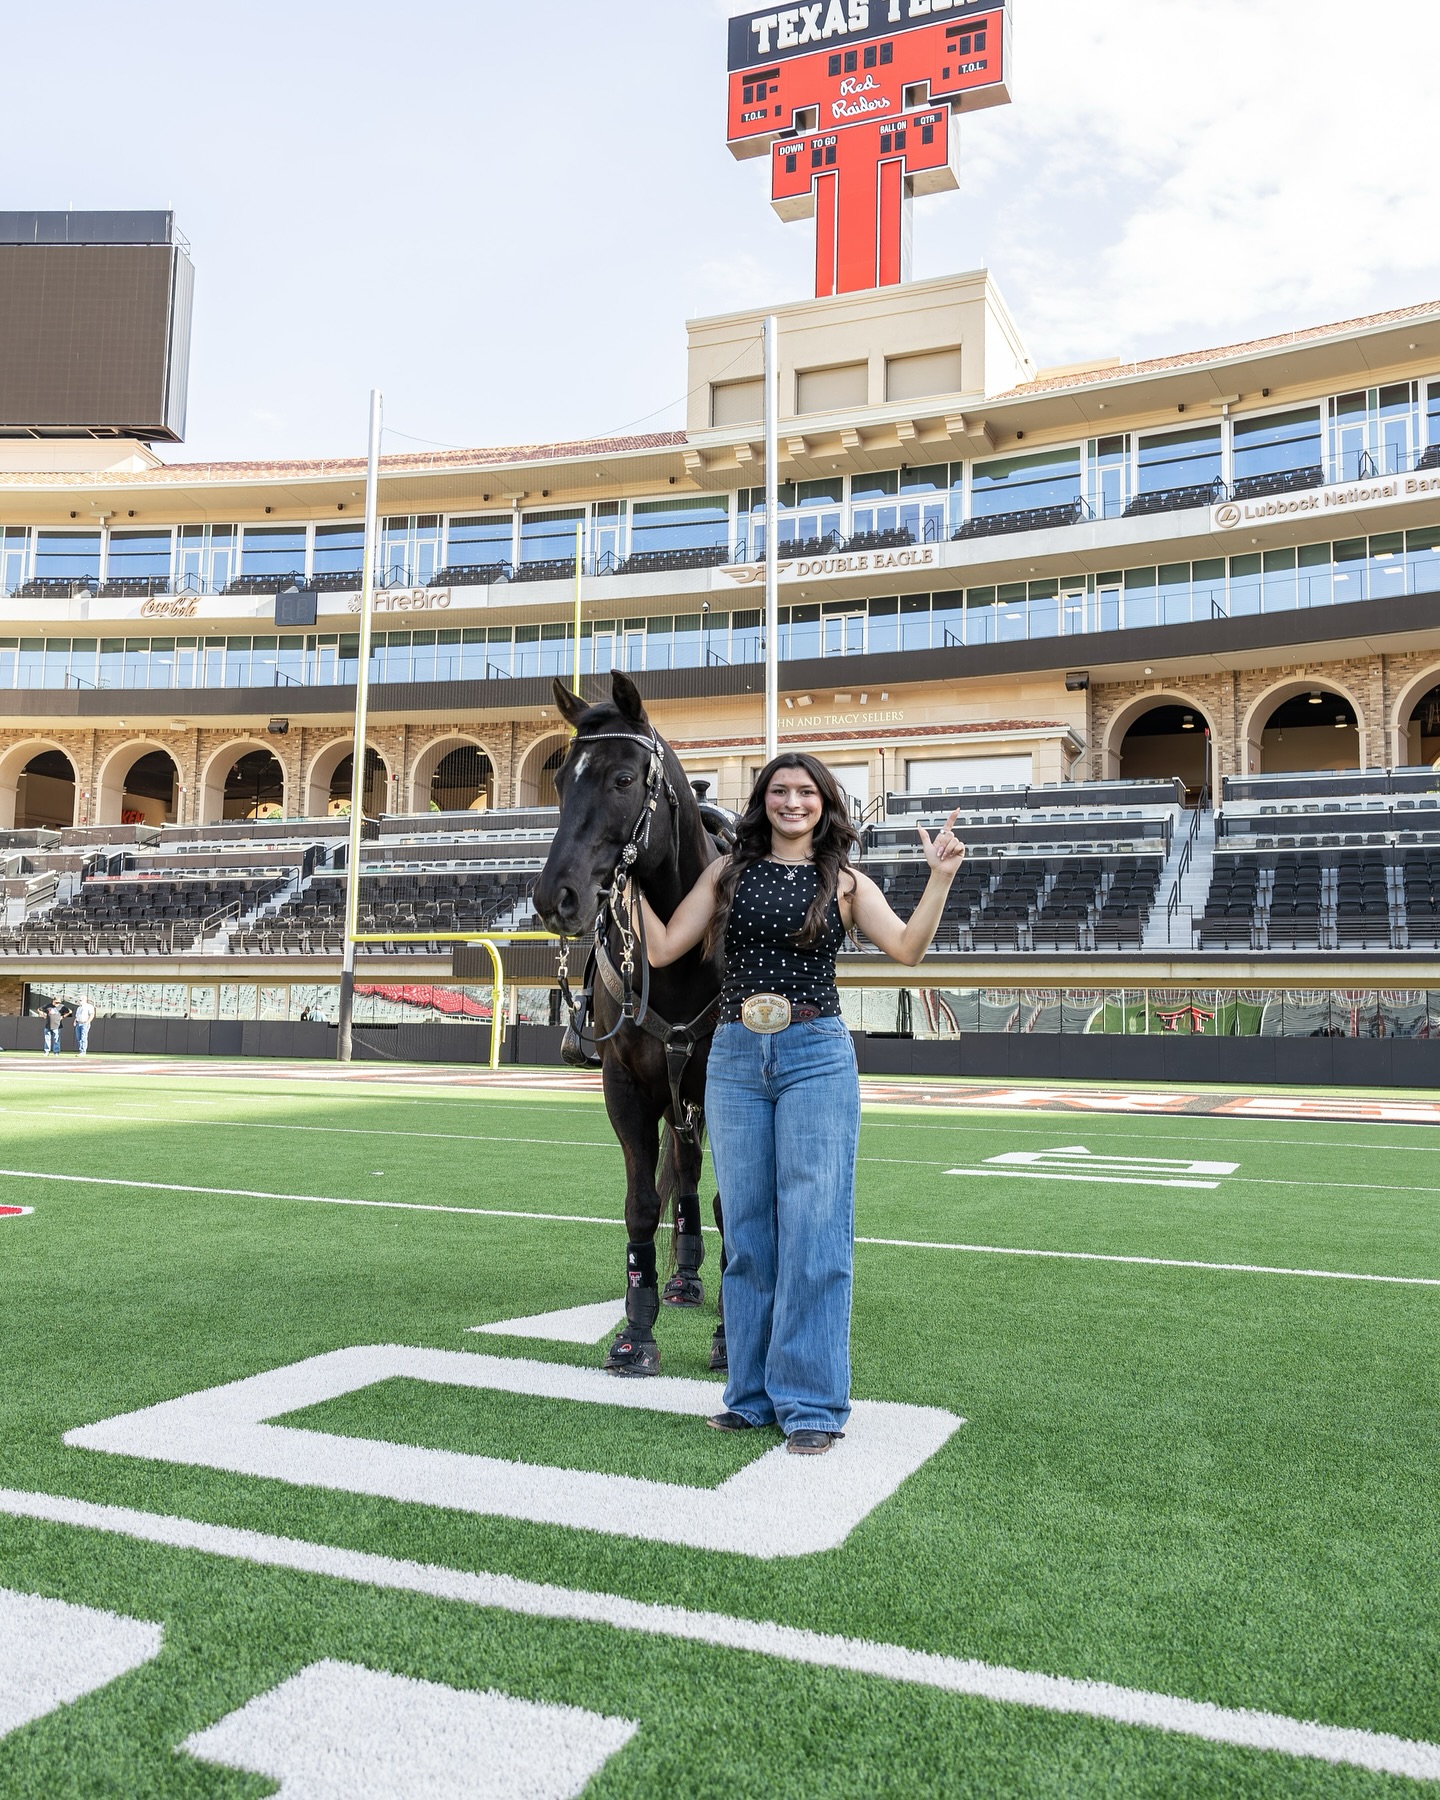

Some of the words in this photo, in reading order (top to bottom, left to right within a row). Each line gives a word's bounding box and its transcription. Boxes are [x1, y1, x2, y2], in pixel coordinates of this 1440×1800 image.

[752, 0, 869, 54] TEXAS
[961, 61, 984, 74] T.O.L.
[840, 74, 880, 97] Red
[744, 112, 764, 122] T.O.L.
[831, 96, 890, 119] Raiders
[880, 122, 896, 134] BALL
[896, 120, 907, 131] ON
[920, 115, 935, 125] QTR
[779, 143, 804, 156] DOWN
[812, 138, 823, 149] TO
[824, 136, 836, 146] GO
[1244, 495, 1320, 520] Lubbock
[1324, 481, 1398, 507] National
[796, 556, 869, 577] DOUBLE
[873, 549, 933, 569] EAGLE
[141, 596, 202, 618] Coca-Cola
[373, 588, 452, 611] FireBird
[796, 716, 822, 727] AND
[824, 713, 860, 726] TRACY
[862, 710, 904, 723] SELLERS
